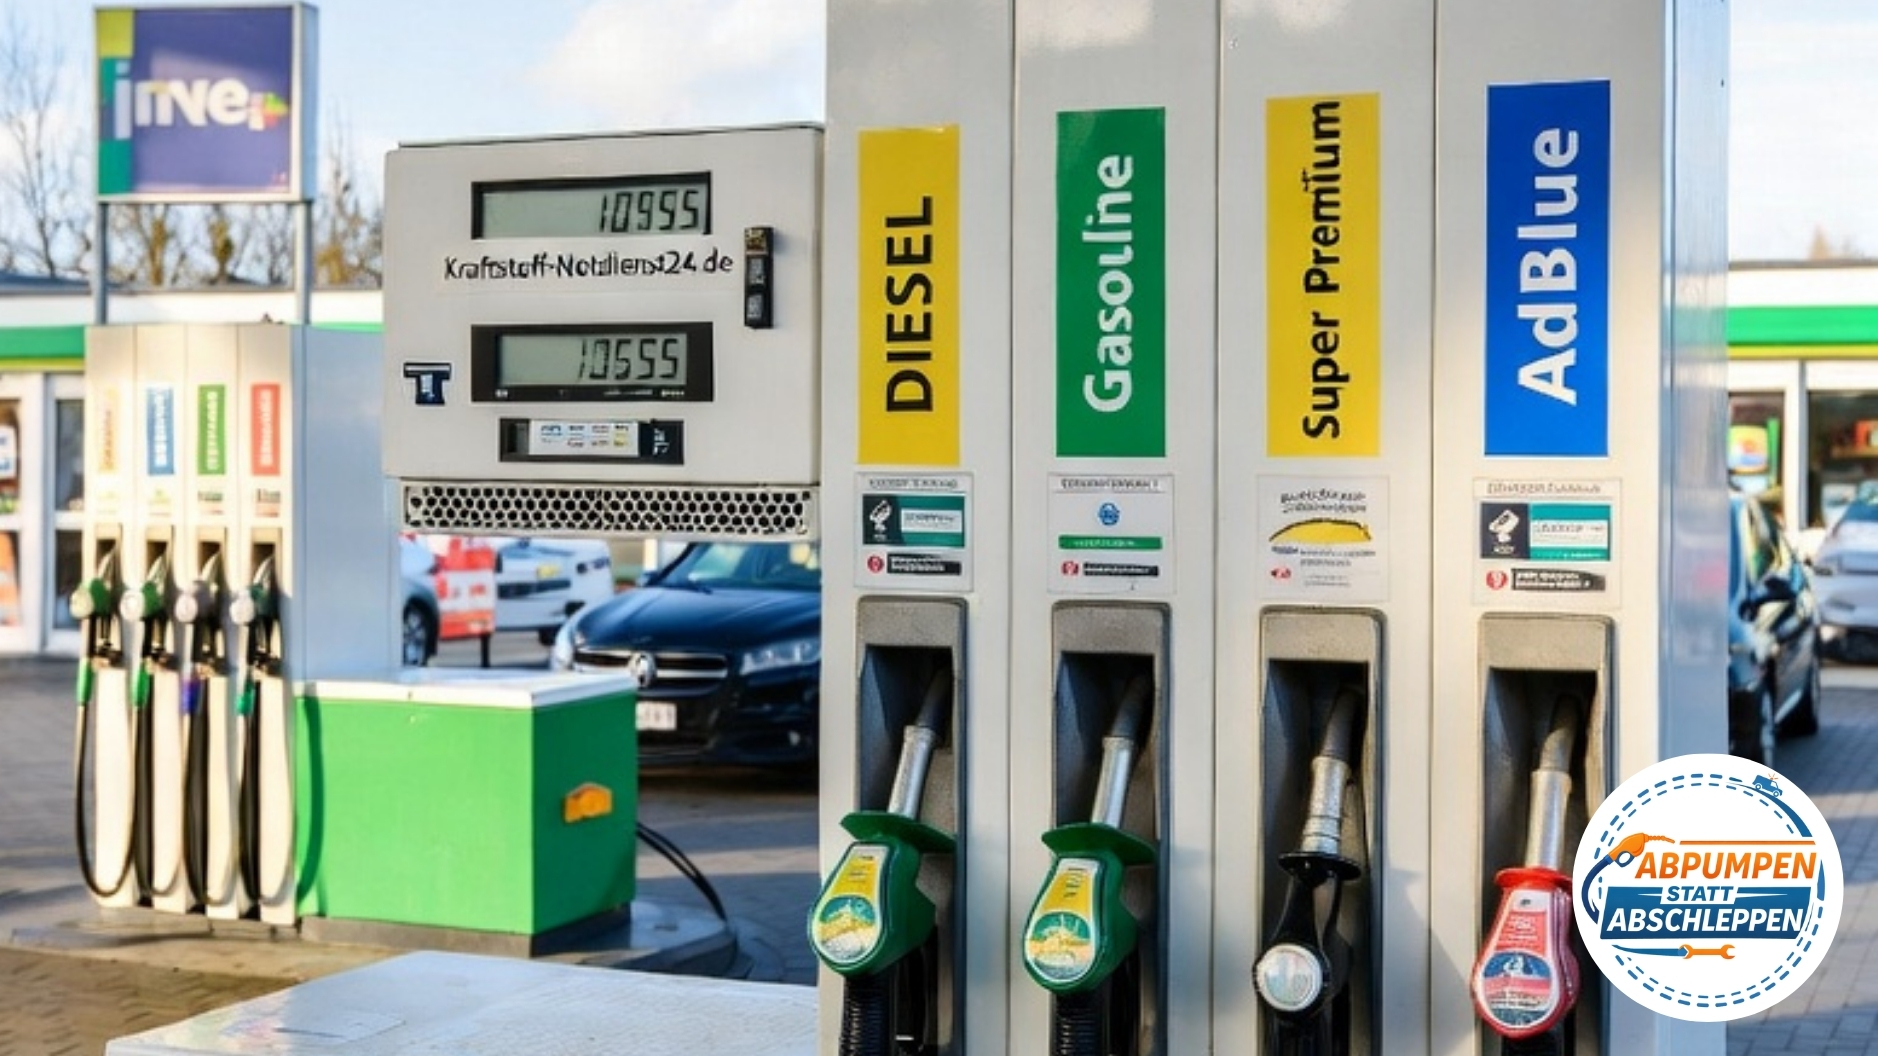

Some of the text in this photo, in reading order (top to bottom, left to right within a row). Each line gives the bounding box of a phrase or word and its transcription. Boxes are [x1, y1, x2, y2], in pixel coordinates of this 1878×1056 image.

[1303, 101, 1341, 294] Premium
[1517, 127, 1579, 406] AdBlue
[885, 196, 933, 412] DIESEL
[1303, 311, 1350, 439] Super
